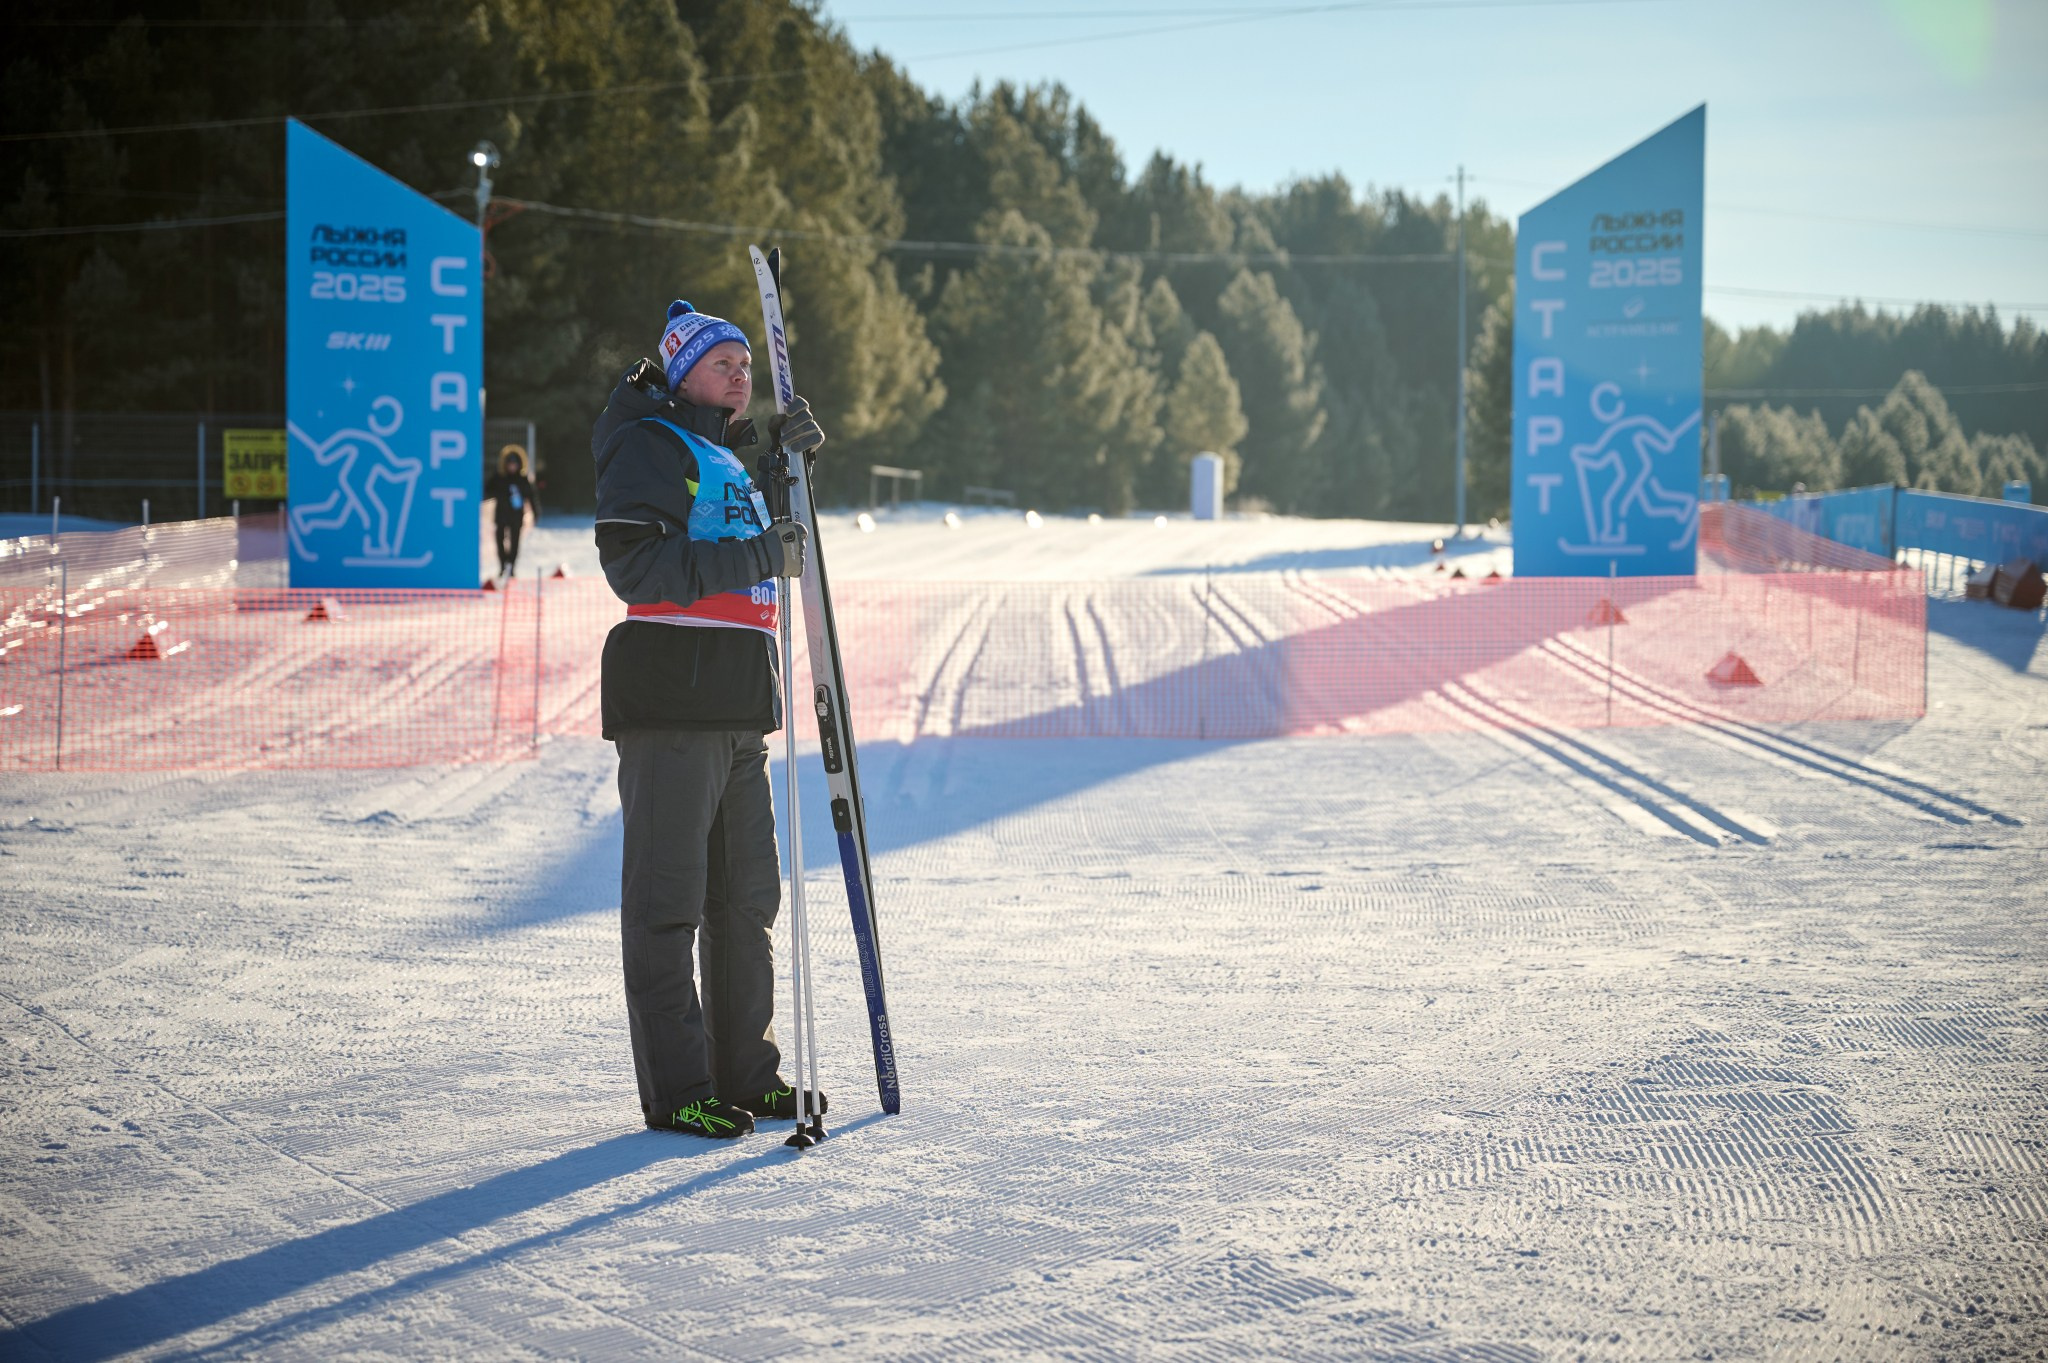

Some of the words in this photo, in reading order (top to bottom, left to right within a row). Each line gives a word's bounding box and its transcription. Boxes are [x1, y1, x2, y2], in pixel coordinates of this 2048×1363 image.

[311, 224, 407, 247] ЛЫЖНЯ
[1590, 209, 1684, 233] ЛЫЖНЯ
[310, 246, 407, 269] РОССИИ
[1589, 233, 1684, 255] РОССИИ
[310, 272, 407, 303] 2025
[1589, 257, 1683, 288] 2025
[676, 330, 715, 370] 2025
[430, 257, 467, 528] СТАРТ
[1527, 241, 1567, 515] СТАРТ
[750, 585, 770, 606] 80
[878, 1014, 898, 1089] NordiCross
